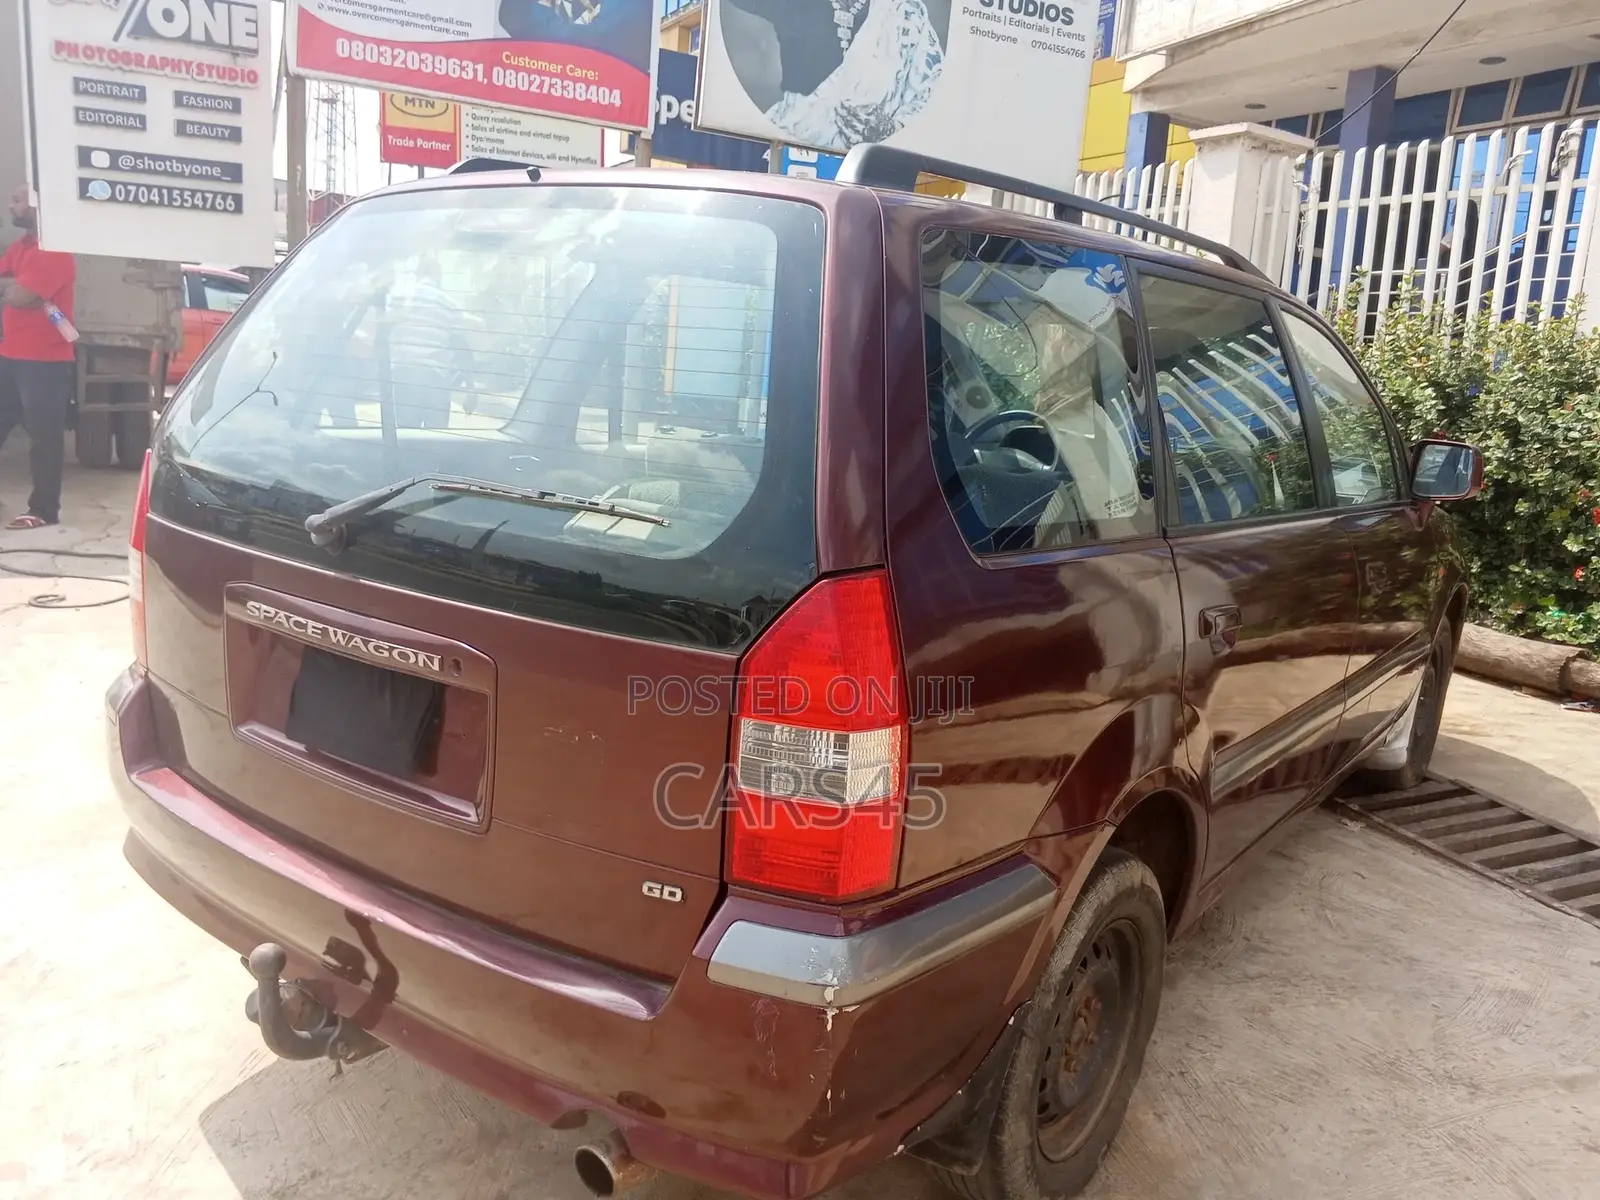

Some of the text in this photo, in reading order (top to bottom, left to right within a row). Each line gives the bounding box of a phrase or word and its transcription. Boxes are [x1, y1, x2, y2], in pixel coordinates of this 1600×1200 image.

[327, 5, 469, 37] www.overcomersgarmentcare.com
[330, 0, 472, 28] rcomersgarmentcare@gmail.com
[962, 6, 1002, 23] Portraits
[1008, 17, 1050, 34] Editorials
[1056, 28, 1086, 42] Events
[969, 26, 1086, 59] Shotbyone 07041554766
[53, 40, 259, 84] PHOTOGRAPHY STUDIO
[335, 37, 488, 84] 08032039631,
[502, 51, 599, 80] Customer Care:
[78, 80, 140, 98] PORTRAIT
[492, 66, 621, 107] 08027338404
[182, 95, 233, 110] FASHION
[404, 95, 436, 109] MTN
[655, 94, 694, 125] pe
[78, 110, 143, 128] EDITORIAL
[186, 123, 230, 138] BEAUTY
[471, 112, 521, 125] Query resolution
[387, 134, 452, 151] Trade Partner
[118, 154, 231, 180] @shotbyone_
[115, 184, 236, 211] 07041554766
[246, 600, 442, 671] SPACE WAGON
